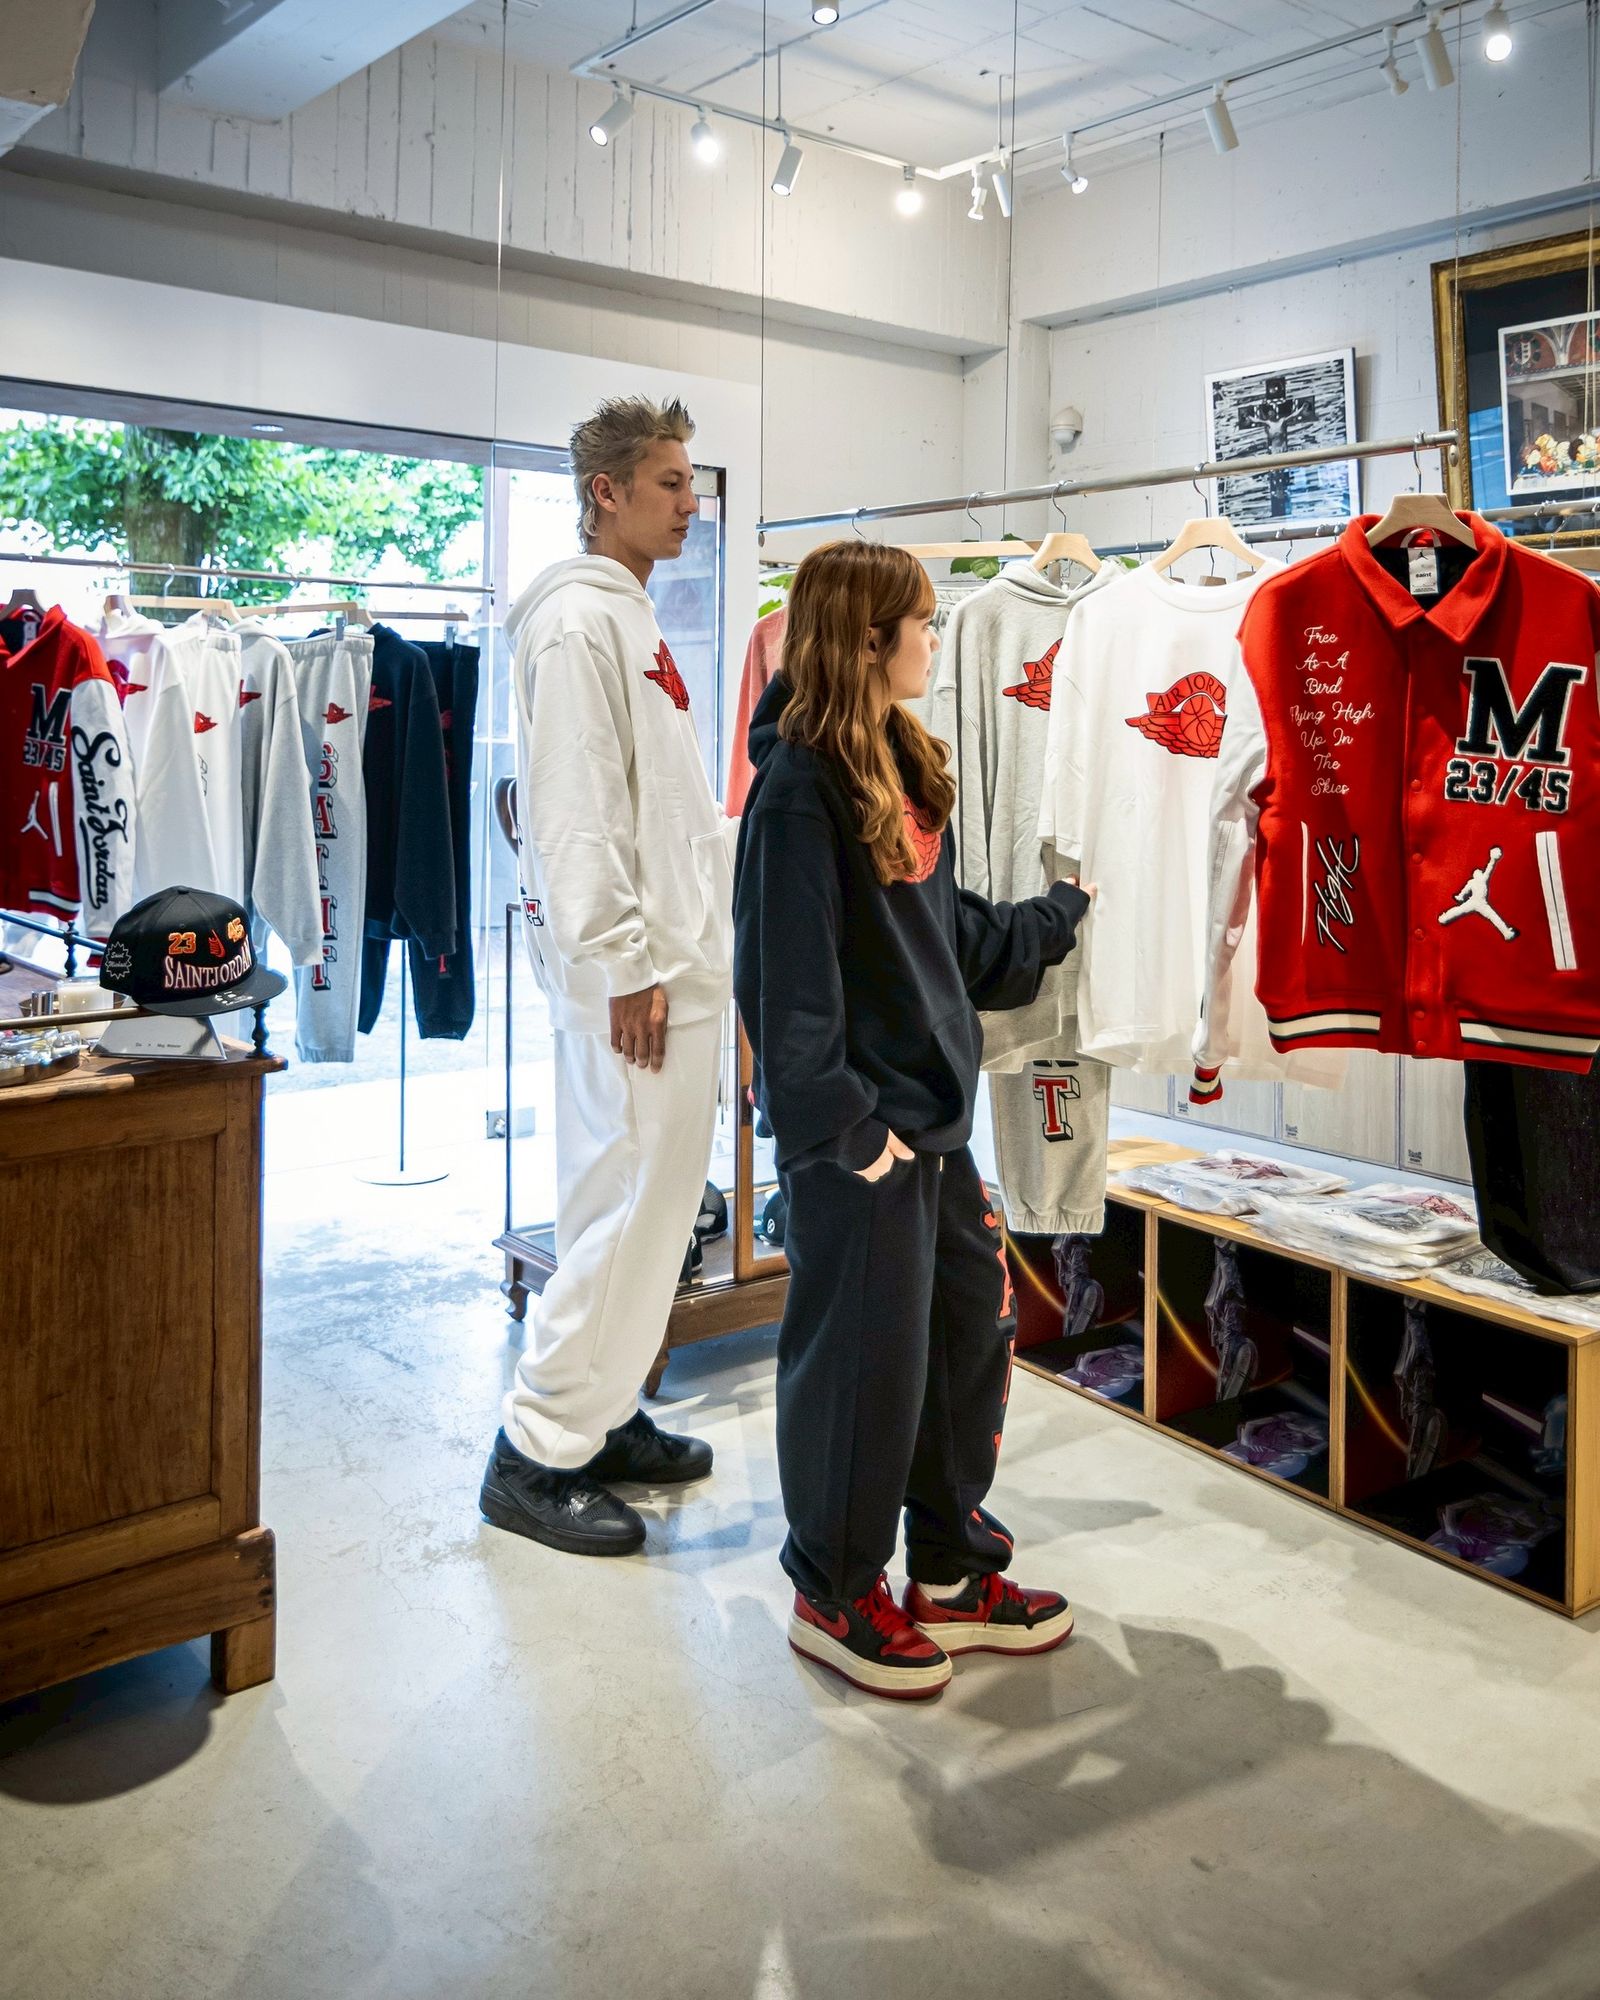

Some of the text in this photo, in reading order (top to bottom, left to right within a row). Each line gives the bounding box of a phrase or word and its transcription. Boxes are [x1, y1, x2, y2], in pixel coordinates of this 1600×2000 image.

[1304, 625, 1338, 645] Free
[1304, 676, 1343, 694] Bird
[1154, 687, 1186, 711] AIR
[1455, 656, 1587, 766] M
[27, 683, 71, 746] M
[1332, 701, 1375, 725] High
[1301, 727, 1354, 750] Up In
[23, 740, 67, 771] 23/45
[1314, 752, 1340, 771] The
[1311, 777, 1350, 796] Skies
[1445, 758, 1573, 814] 23/45
[227, 917, 246, 943] 45
[168, 932, 197, 955] 23
